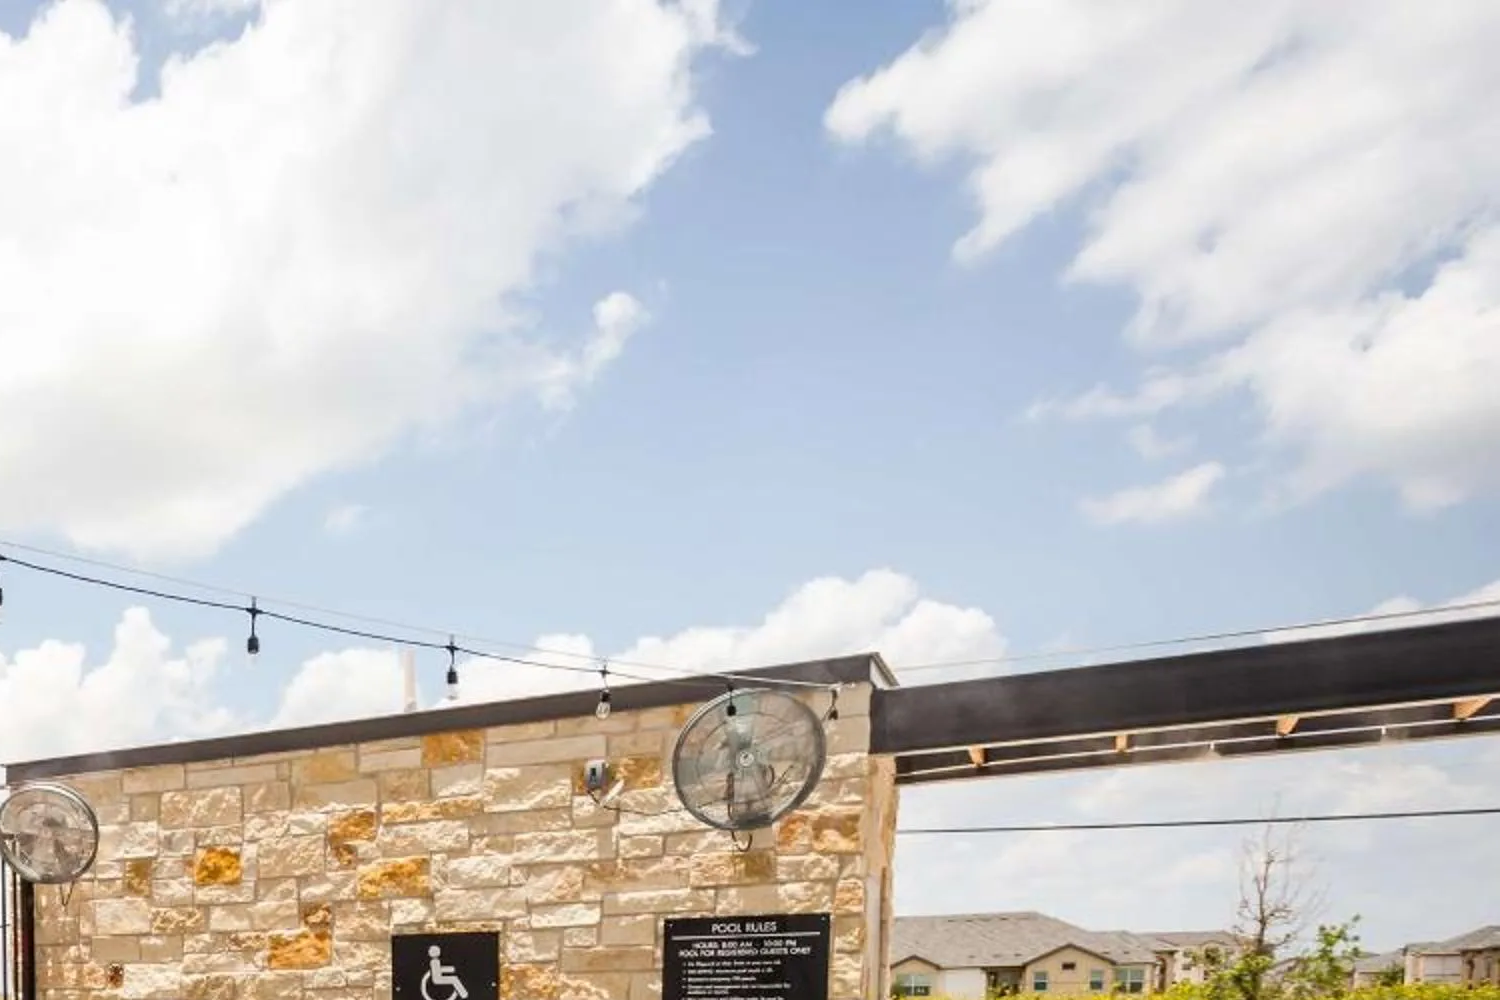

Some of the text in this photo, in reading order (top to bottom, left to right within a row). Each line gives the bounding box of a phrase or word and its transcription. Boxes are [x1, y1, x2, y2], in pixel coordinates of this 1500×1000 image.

[711, 921, 777, 934] POOL RULES
[739, 940, 753, 948] AM
[699, 949, 715, 957] FOR
